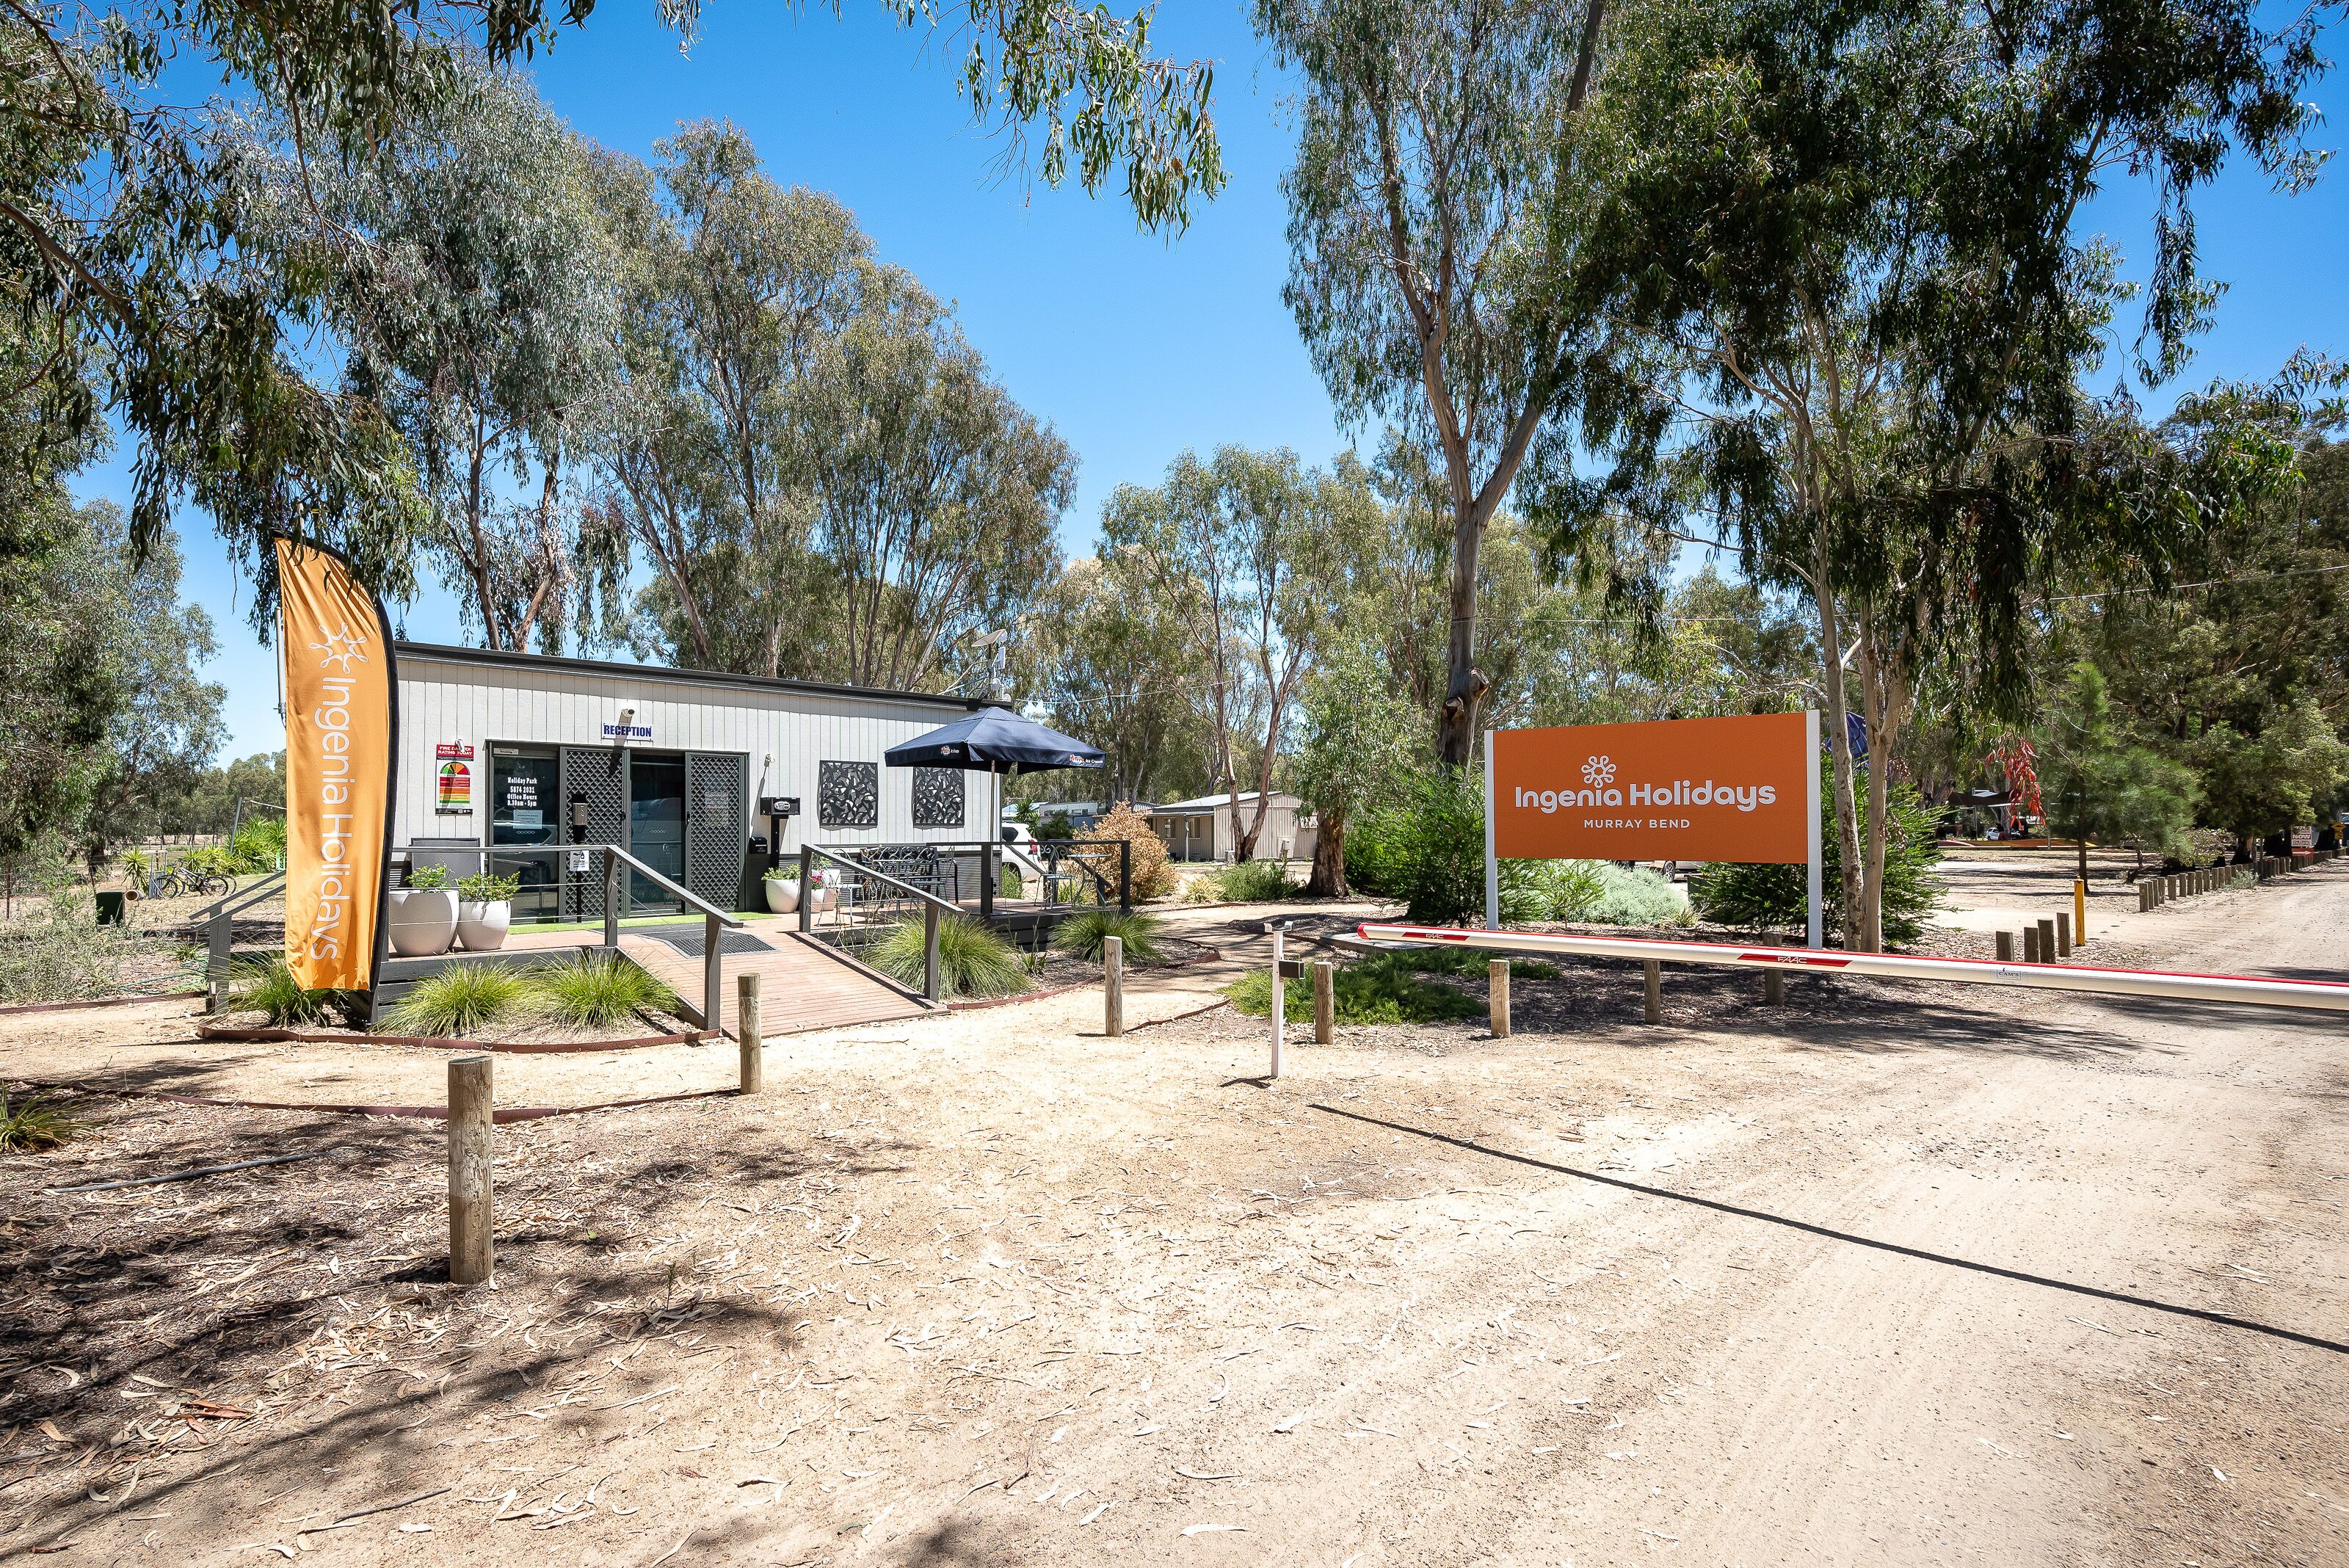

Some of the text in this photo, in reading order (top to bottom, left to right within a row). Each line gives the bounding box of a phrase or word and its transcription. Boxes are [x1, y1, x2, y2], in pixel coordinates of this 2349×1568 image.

[603, 725, 652, 737] RECEPTION
[507, 777, 526, 785] Holiday
[1515, 780, 1776, 813] Ingenia Holidays
[311, 676, 356, 962] Ingenia Holidays
[1583, 819, 1691, 829] MURRAY BEND
